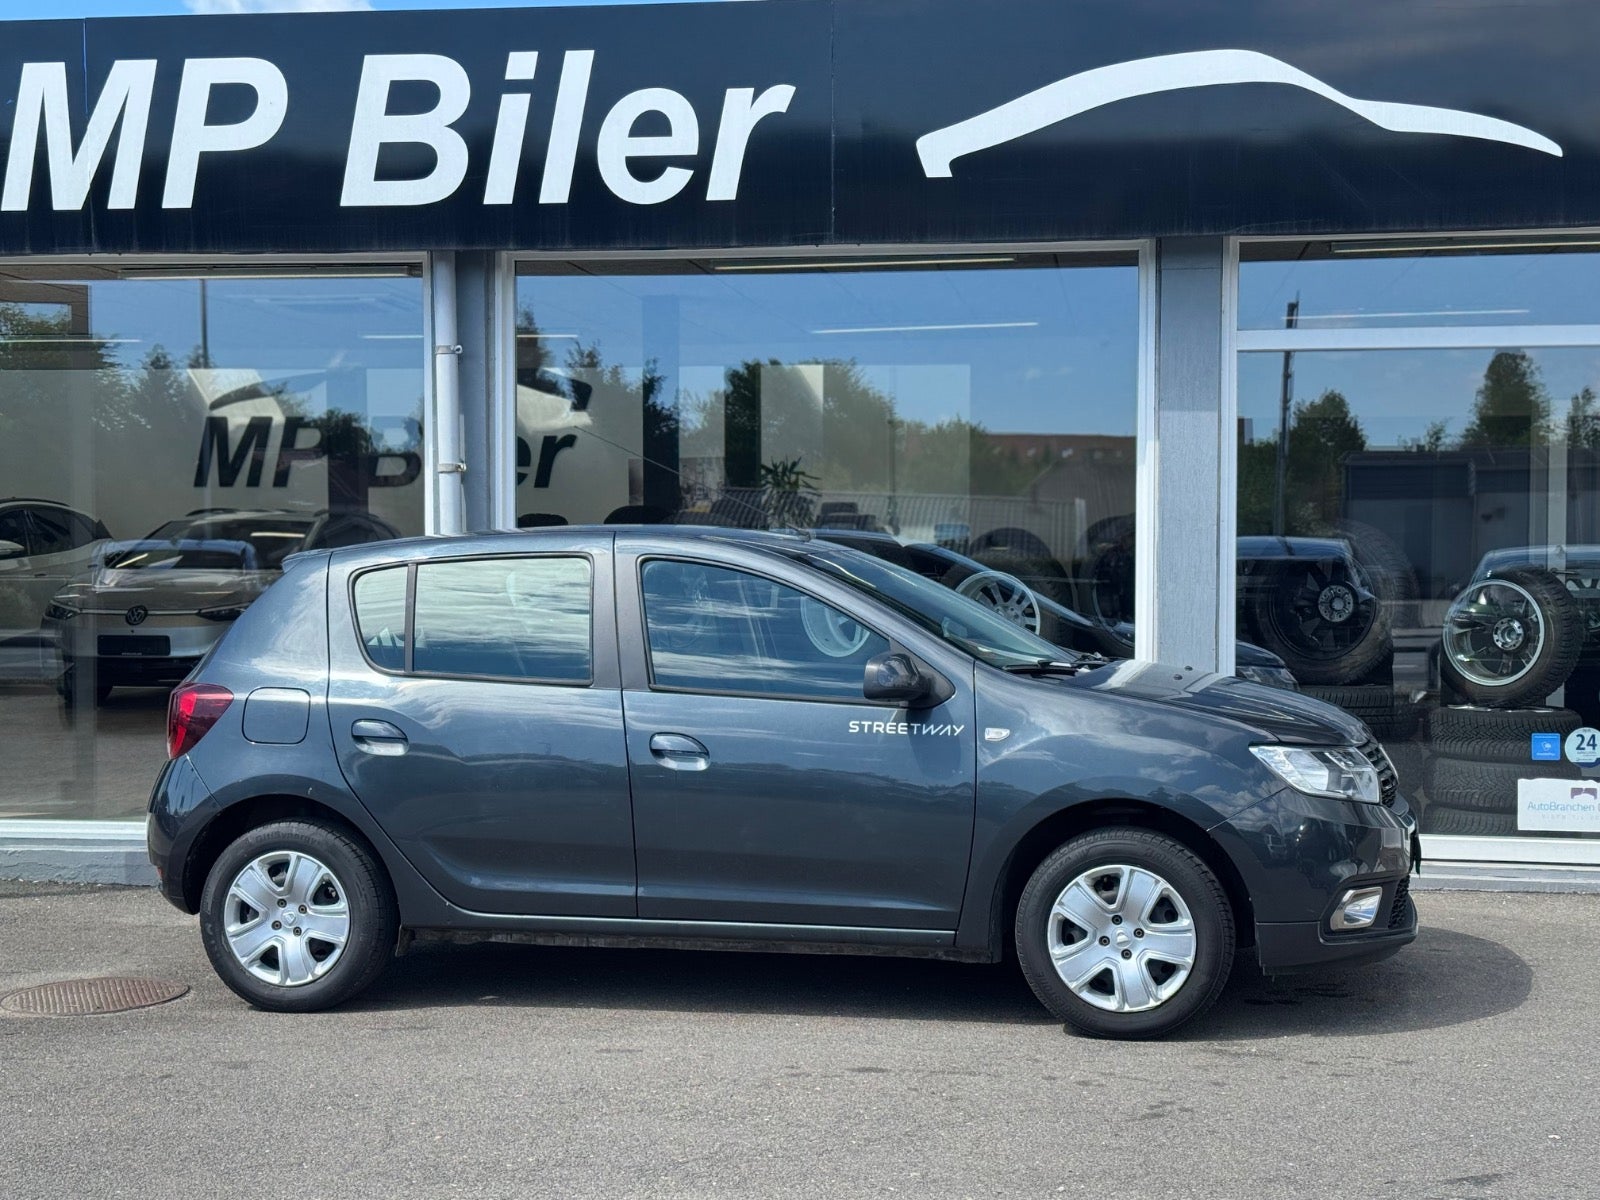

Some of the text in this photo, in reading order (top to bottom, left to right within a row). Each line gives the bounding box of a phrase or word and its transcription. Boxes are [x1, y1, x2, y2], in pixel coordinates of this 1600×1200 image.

[0, 49, 796, 212] MP Biler
[193, 416, 326, 488] MP
[848, 720, 965, 736] STREETWAY
[1575, 733, 1598, 751] 24
[1527, 801, 1595, 812] AutoBranchen
